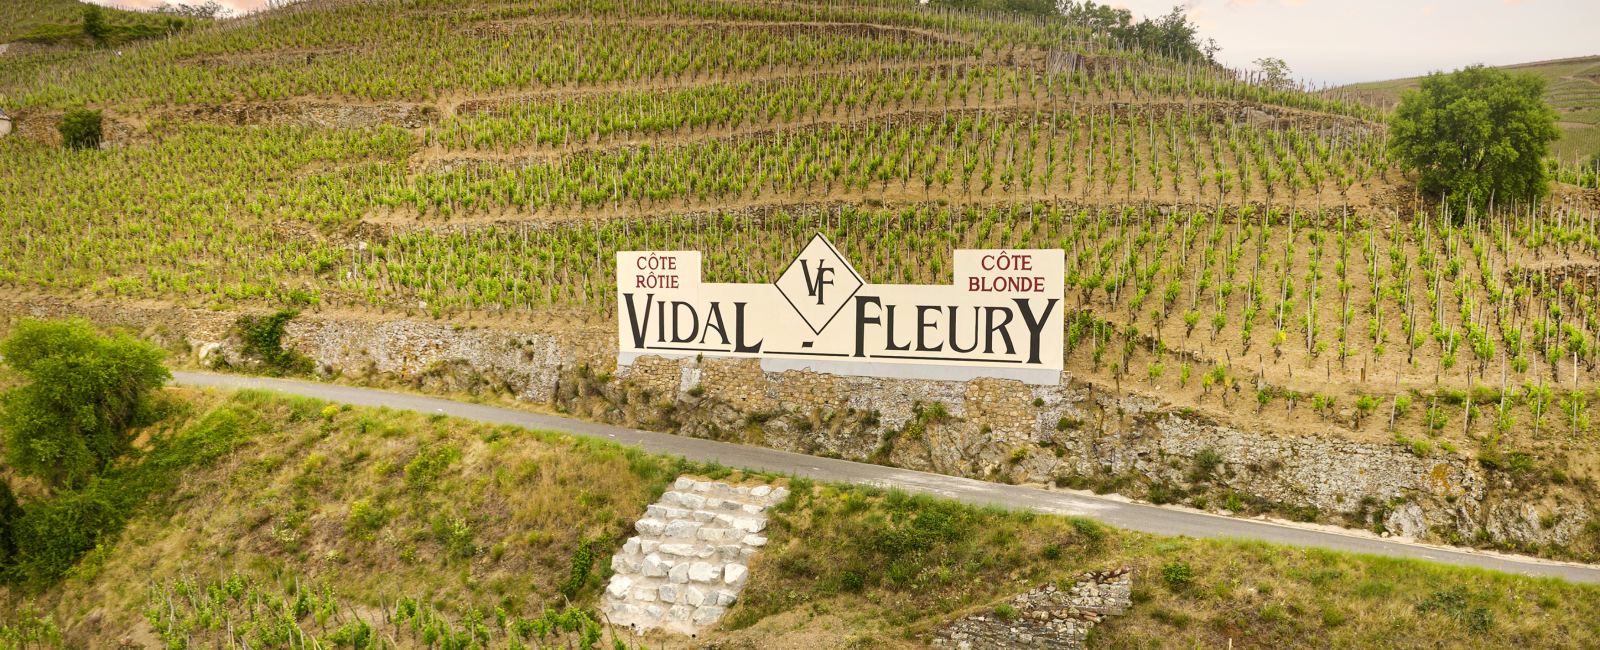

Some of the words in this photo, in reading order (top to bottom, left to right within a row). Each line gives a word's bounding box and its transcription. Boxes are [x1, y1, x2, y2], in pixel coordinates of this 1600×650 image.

[636, 251, 677, 270] CÔTE
[981, 250, 1033, 271] CÔTE
[635, 271, 679, 289] RÔTIE
[969, 276, 1046, 292] BLONDE
[623, 293, 764, 353] VIDAL
[852, 295, 1060, 364] FLEURY
